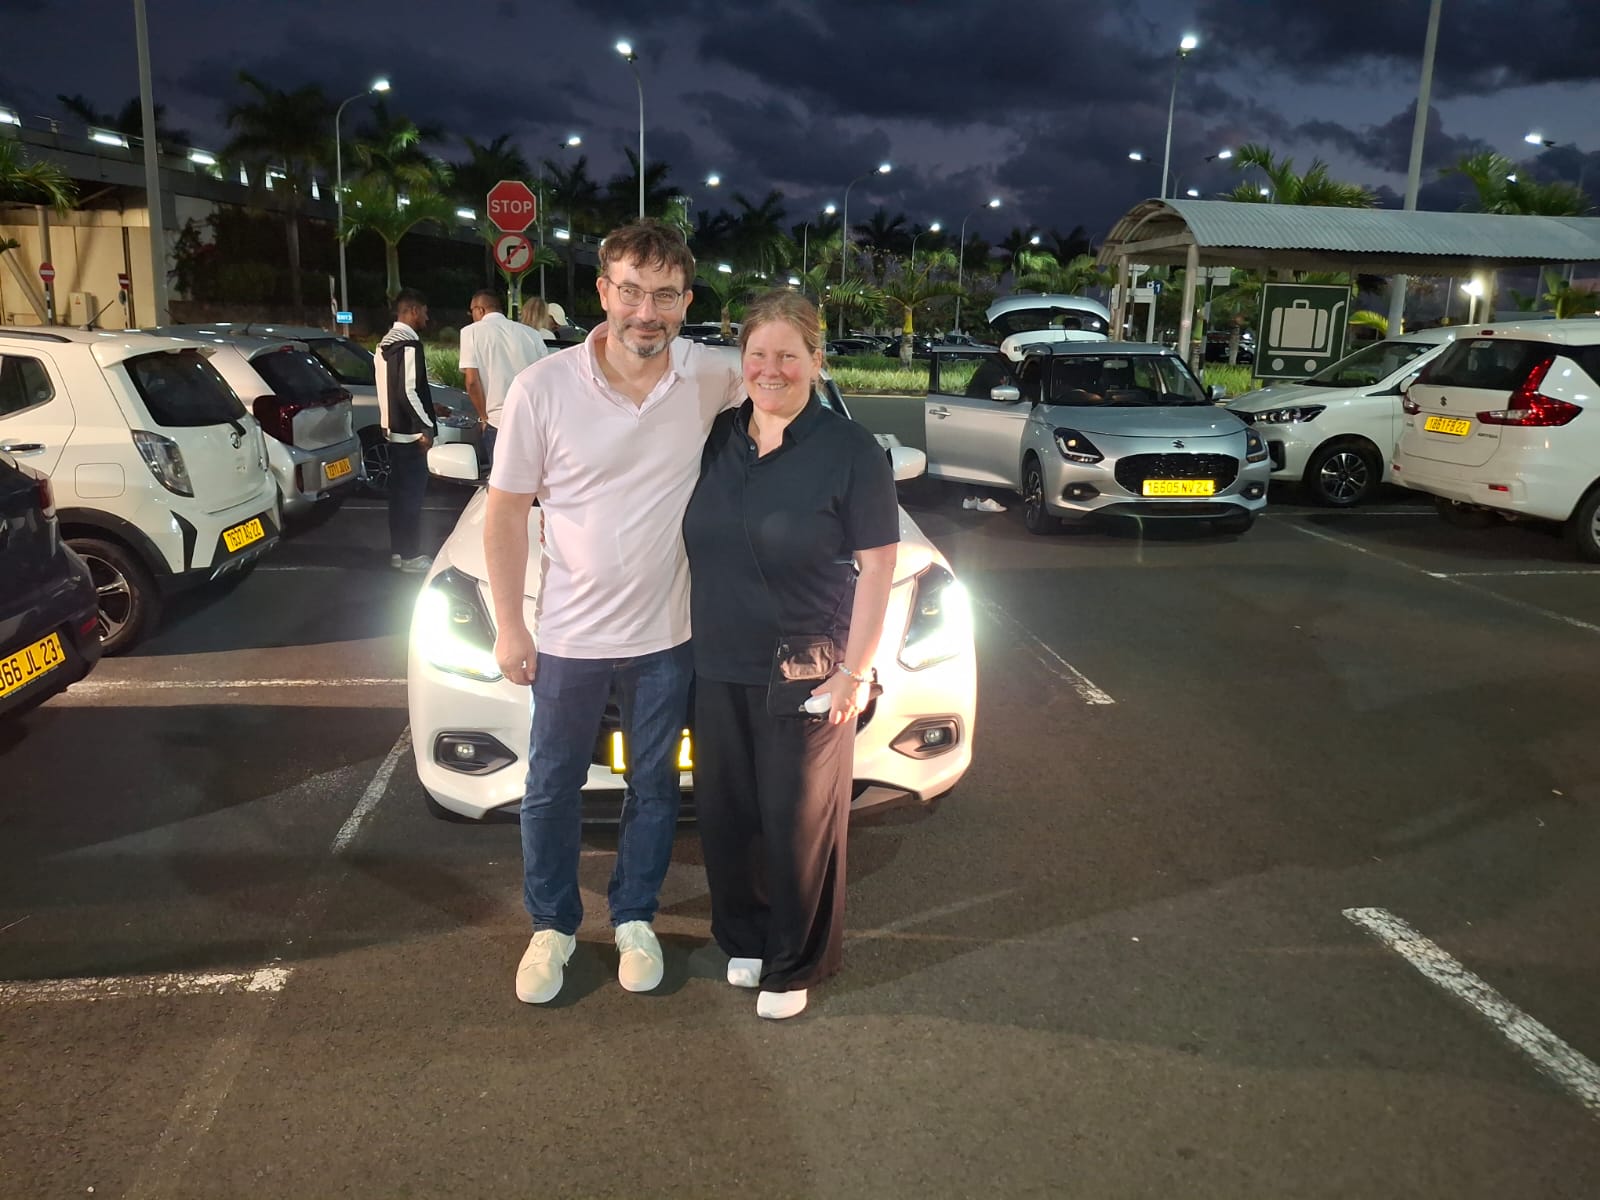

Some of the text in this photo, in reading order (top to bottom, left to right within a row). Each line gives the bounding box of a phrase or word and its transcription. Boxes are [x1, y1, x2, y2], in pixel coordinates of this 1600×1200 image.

[491, 199, 532, 214] STOP
[1148, 482, 1208, 494] 16605 NV 24
[227, 528, 244, 548] 7637
[249, 521, 261, 537] 22
[26, 650, 42, 675] JL
[40, 638, 58, 666] 23
